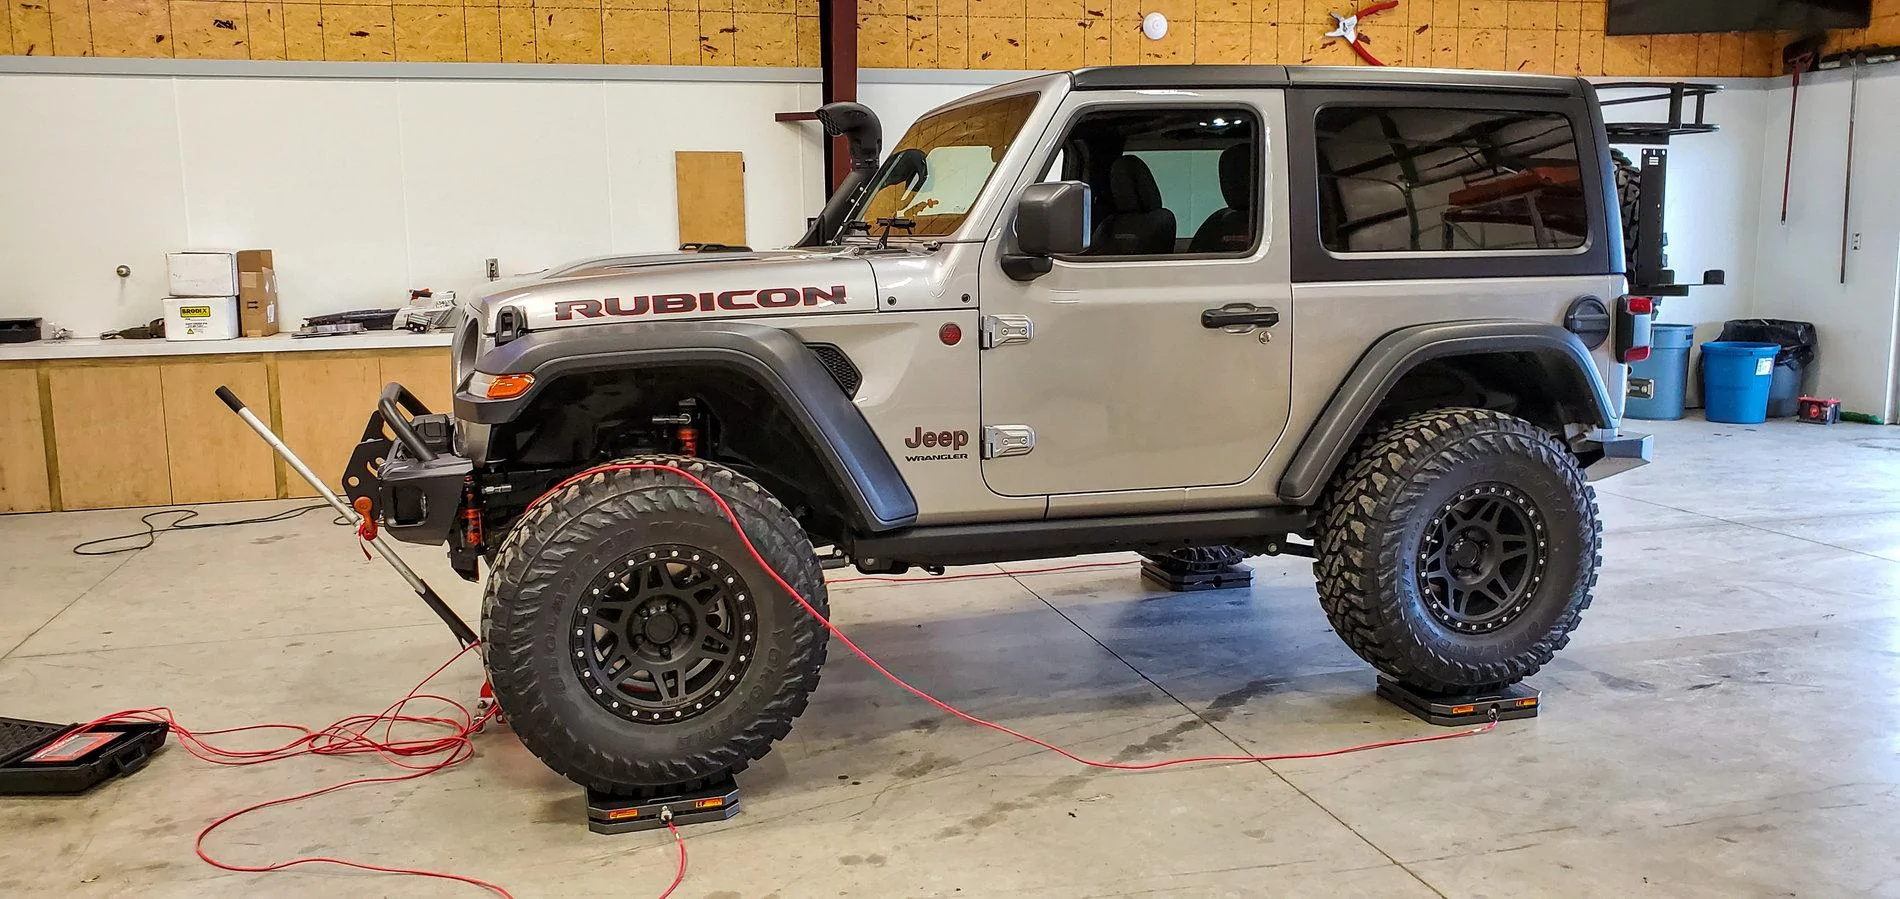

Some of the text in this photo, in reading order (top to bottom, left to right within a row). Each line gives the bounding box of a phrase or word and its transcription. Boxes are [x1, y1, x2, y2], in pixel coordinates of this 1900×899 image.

[555, 285, 847, 320] RUBICON
[904, 427, 969, 450] Jeep
[905, 453, 968, 462] WRANGLER
